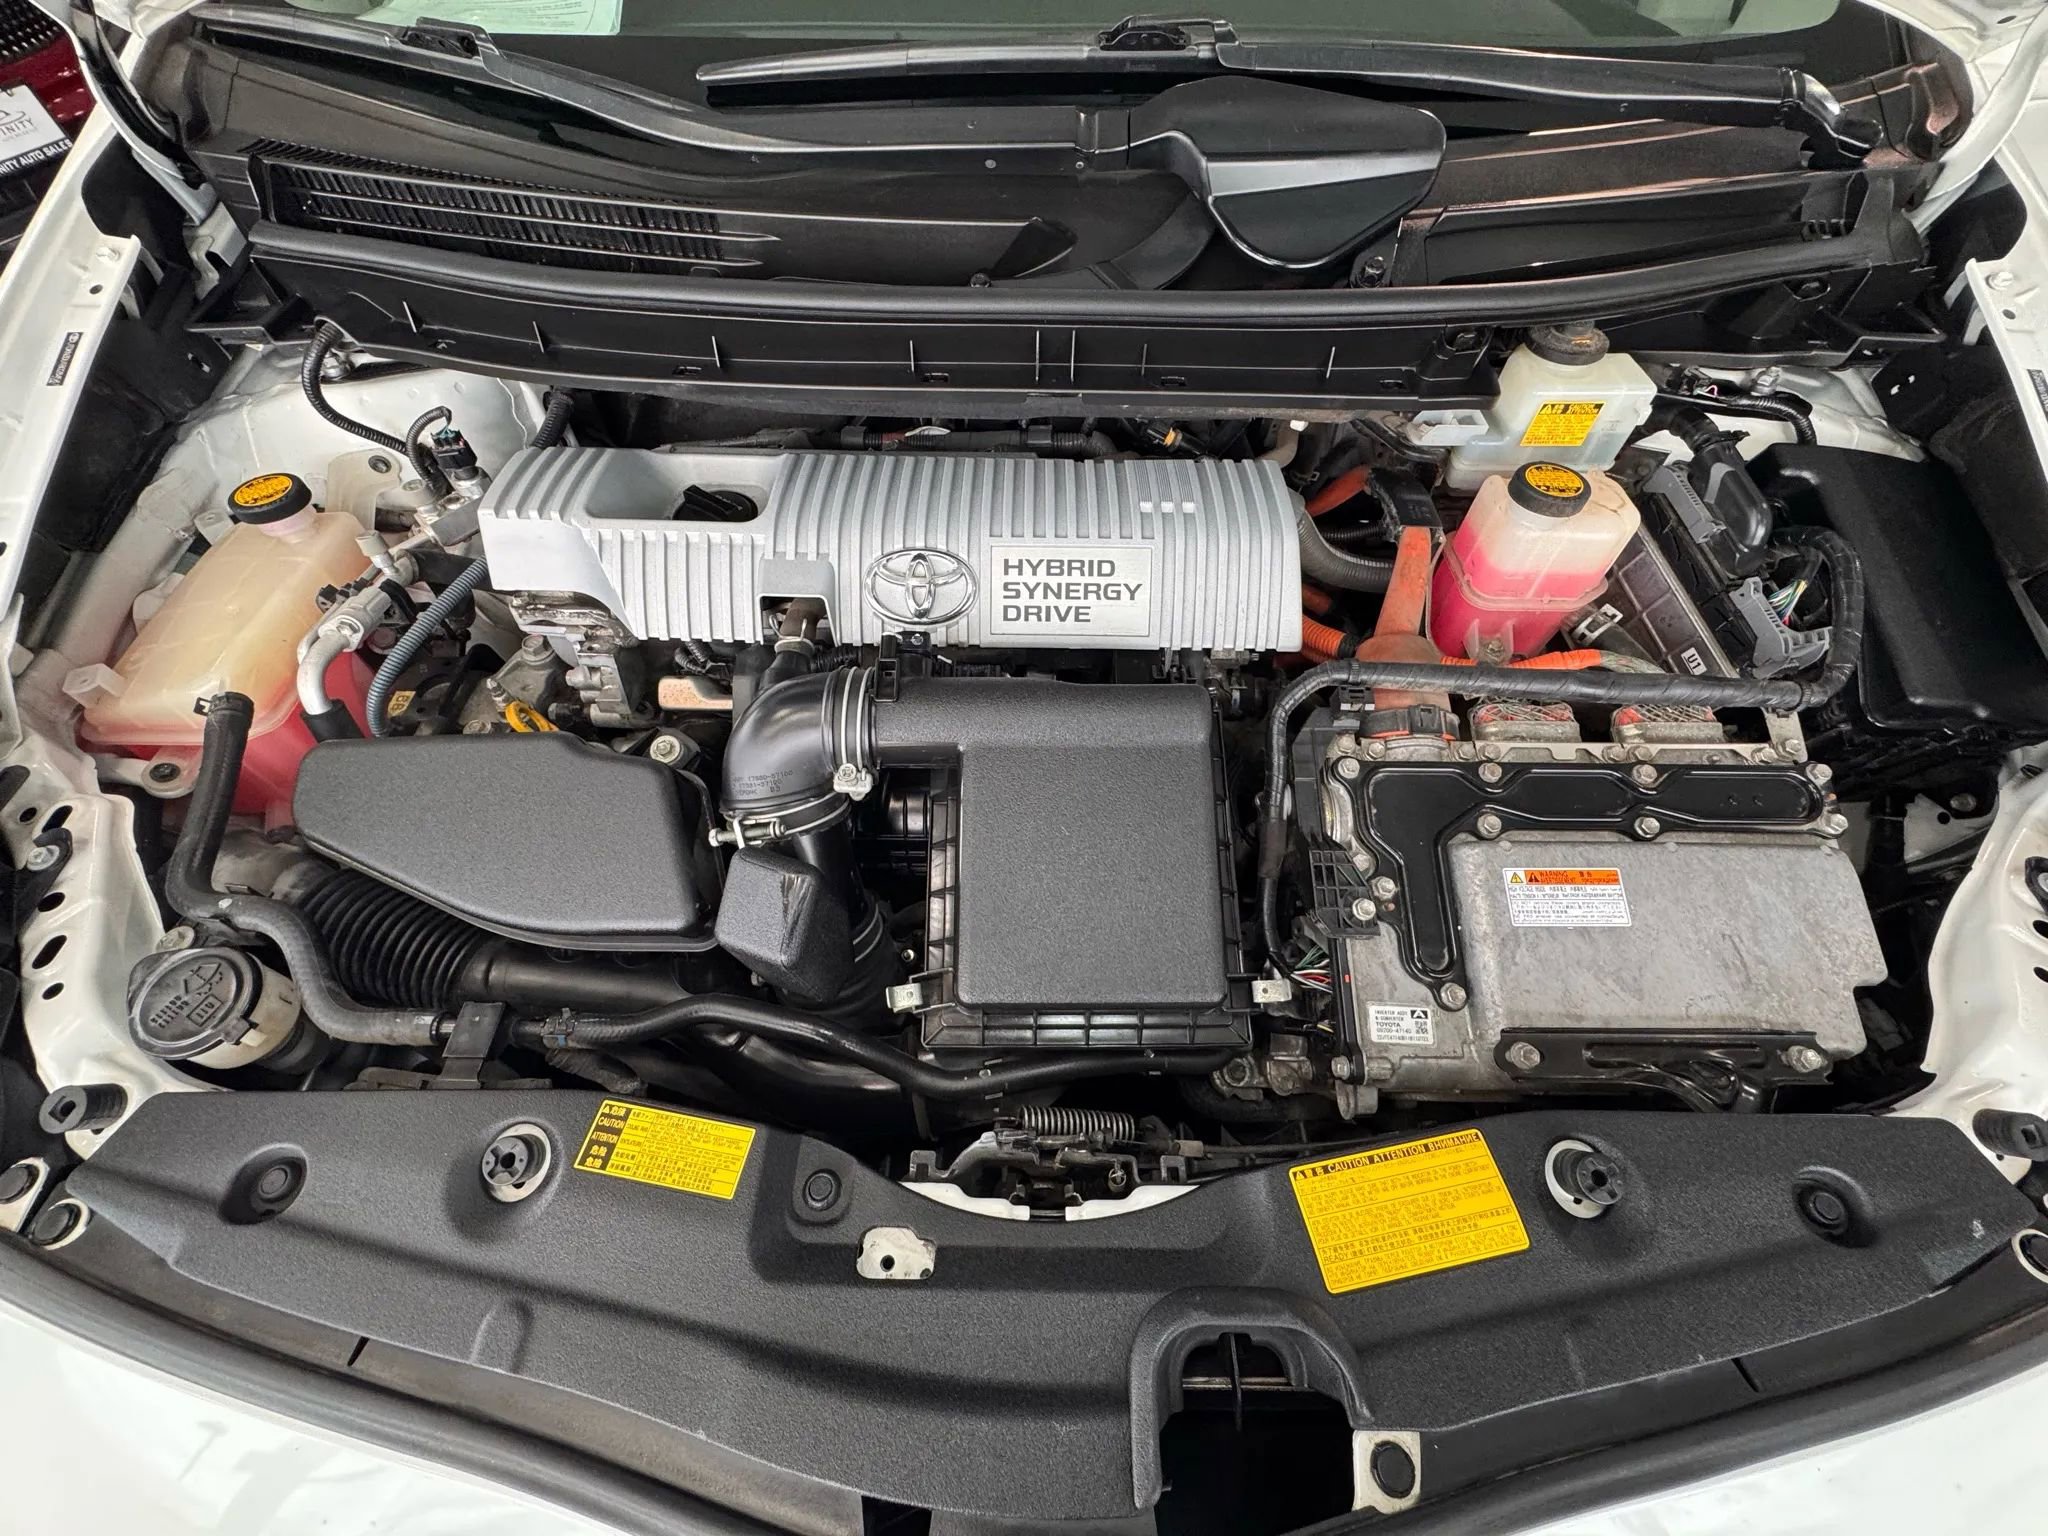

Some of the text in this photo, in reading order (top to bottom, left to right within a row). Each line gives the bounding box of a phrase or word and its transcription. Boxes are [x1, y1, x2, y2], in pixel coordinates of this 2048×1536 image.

[19, 150, 45, 166] AUTO
[42, 139, 73, 156] SALES
[1003, 558, 1116, 577] HYBRID
[1002, 582, 1143, 601] SYNERGY
[1002, 605, 1092, 623] DRIVE
[1687, 653, 1702, 670] U1
[598, 1117, 626, 1129] CAUTION
[591, 1131, 620, 1144] ATTENTION
[1327, 1157, 1370, 1173] CAUTION
[1373, 1144, 1426, 1164] ATTENTION
[1428, 1133, 1480, 1152] ВНИМАНИЕ
[1323, 1252, 1349, 1264] READY
